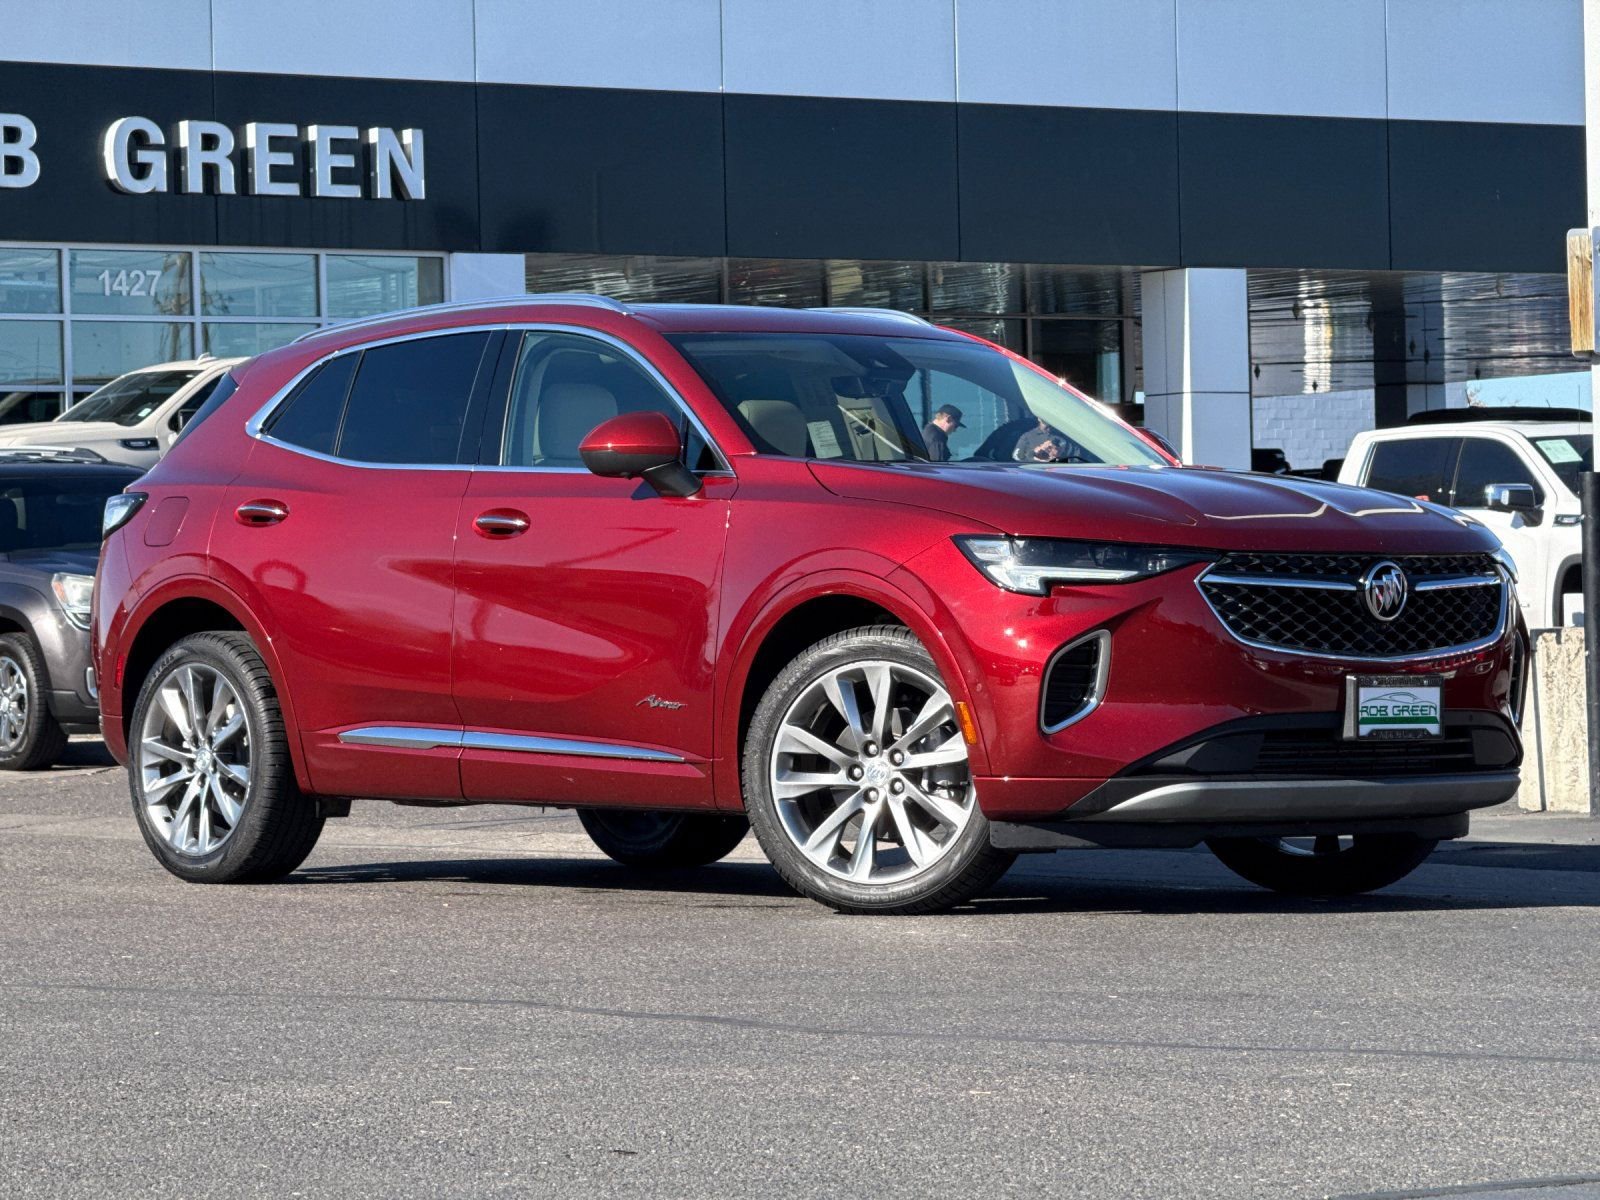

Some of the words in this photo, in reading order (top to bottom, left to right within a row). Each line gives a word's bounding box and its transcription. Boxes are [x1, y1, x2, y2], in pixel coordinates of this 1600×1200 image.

[103, 115, 426, 200] GREEN
[99, 269, 162, 297] 1427
[1360, 705, 1389, 716] ROB
[1392, 705, 1438, 716] GREEN
